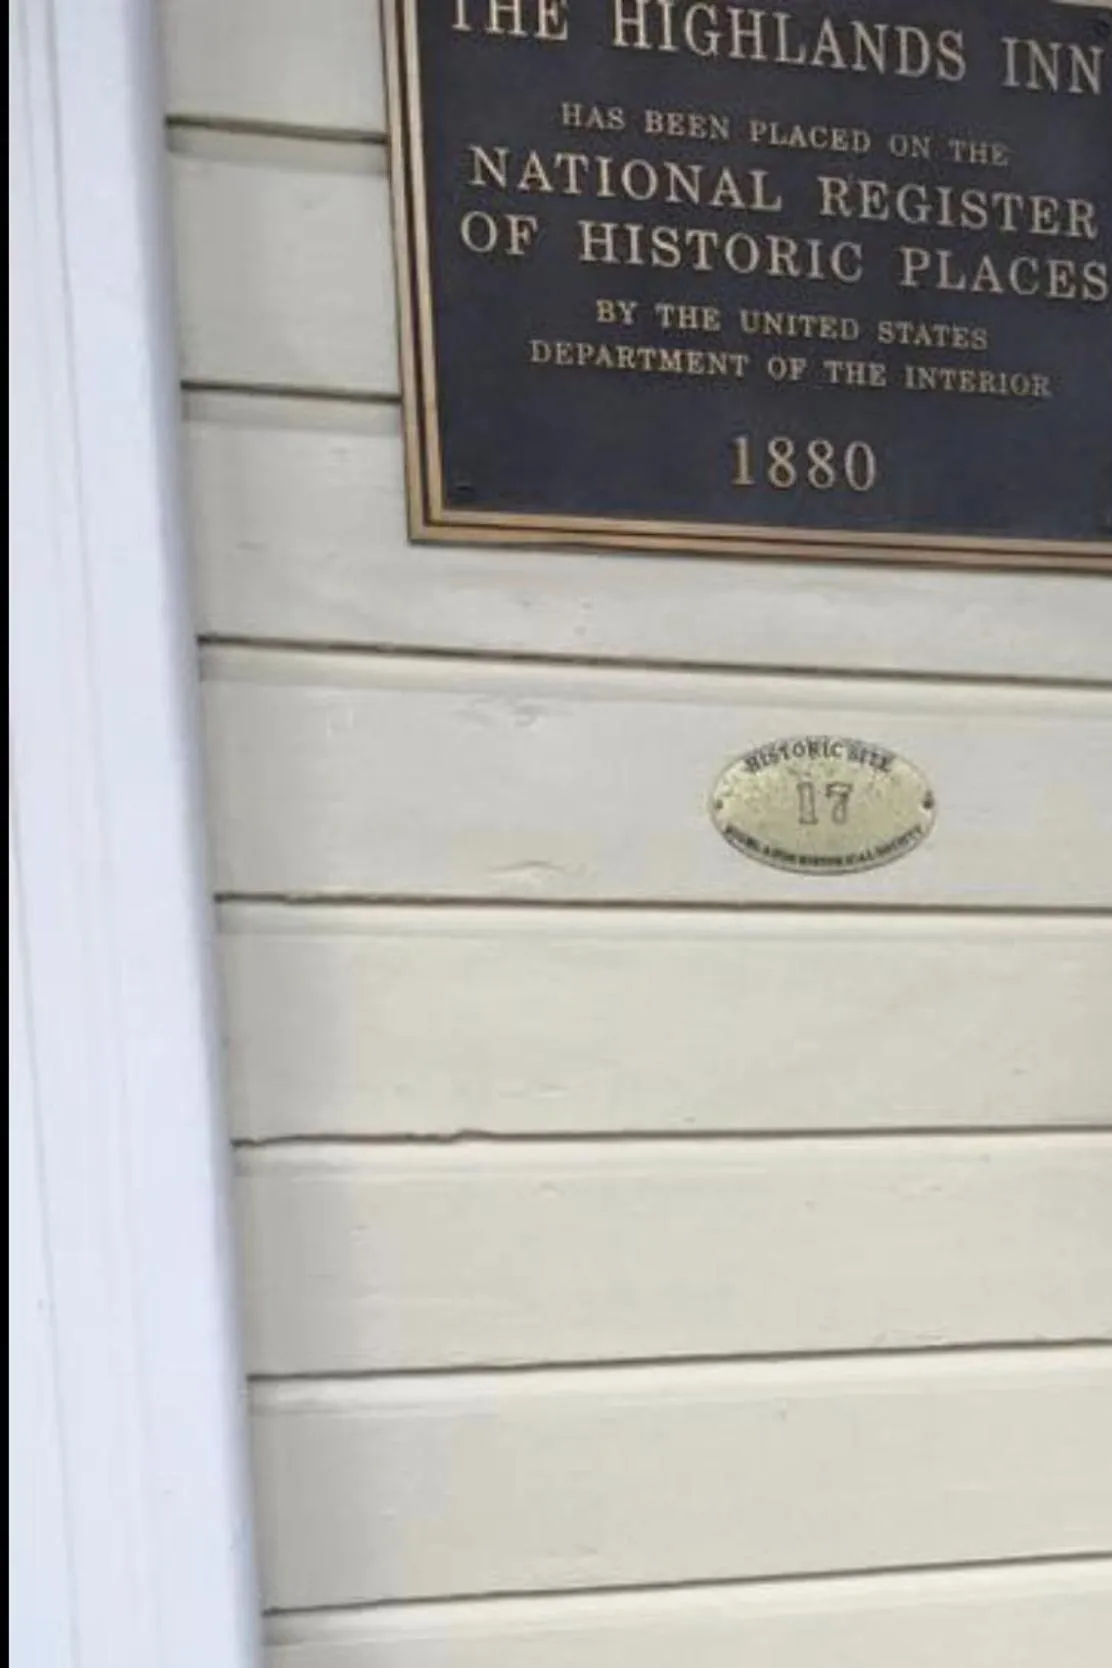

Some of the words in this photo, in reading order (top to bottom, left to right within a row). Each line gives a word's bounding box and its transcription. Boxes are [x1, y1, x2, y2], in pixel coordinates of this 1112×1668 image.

[613, 0, 968, 82] HIGHLANDS
[1002, 38, 1104, 95] INN
[562, 104, 625, 131] HAS
[645, 109, 730, 140] BEEN
[750, 121, 871, 153] PLACED
[889, 135, 931, 158] ON
[950, 139, 1009, 167] THE
[468, 146, 782, 211] NATIONAL
[818, 176, 1098, 239] REGISTER
[461, 211, 538, 256] OF
[580, 220, 864, 283] HISTORIC
[901, 248, 1109, 302] PLACES
[595, 300, 637, 327] BY
[655, 303, 721, 332] THE
[740, 310, 861, 341] UNITED
[877, 319, 989, 352] STATES
[530, 339, 750, 379] DEPARTMENT
[767, 356, 808, 381] OF
[825, 360, 887, 388] THE
[905, 367, 1053, 399] INTERIOR
[731, 436, 878, 493] 1880
[743, 737, 844, 773] HISTORIC
[796, 780, 854, 826] 17
